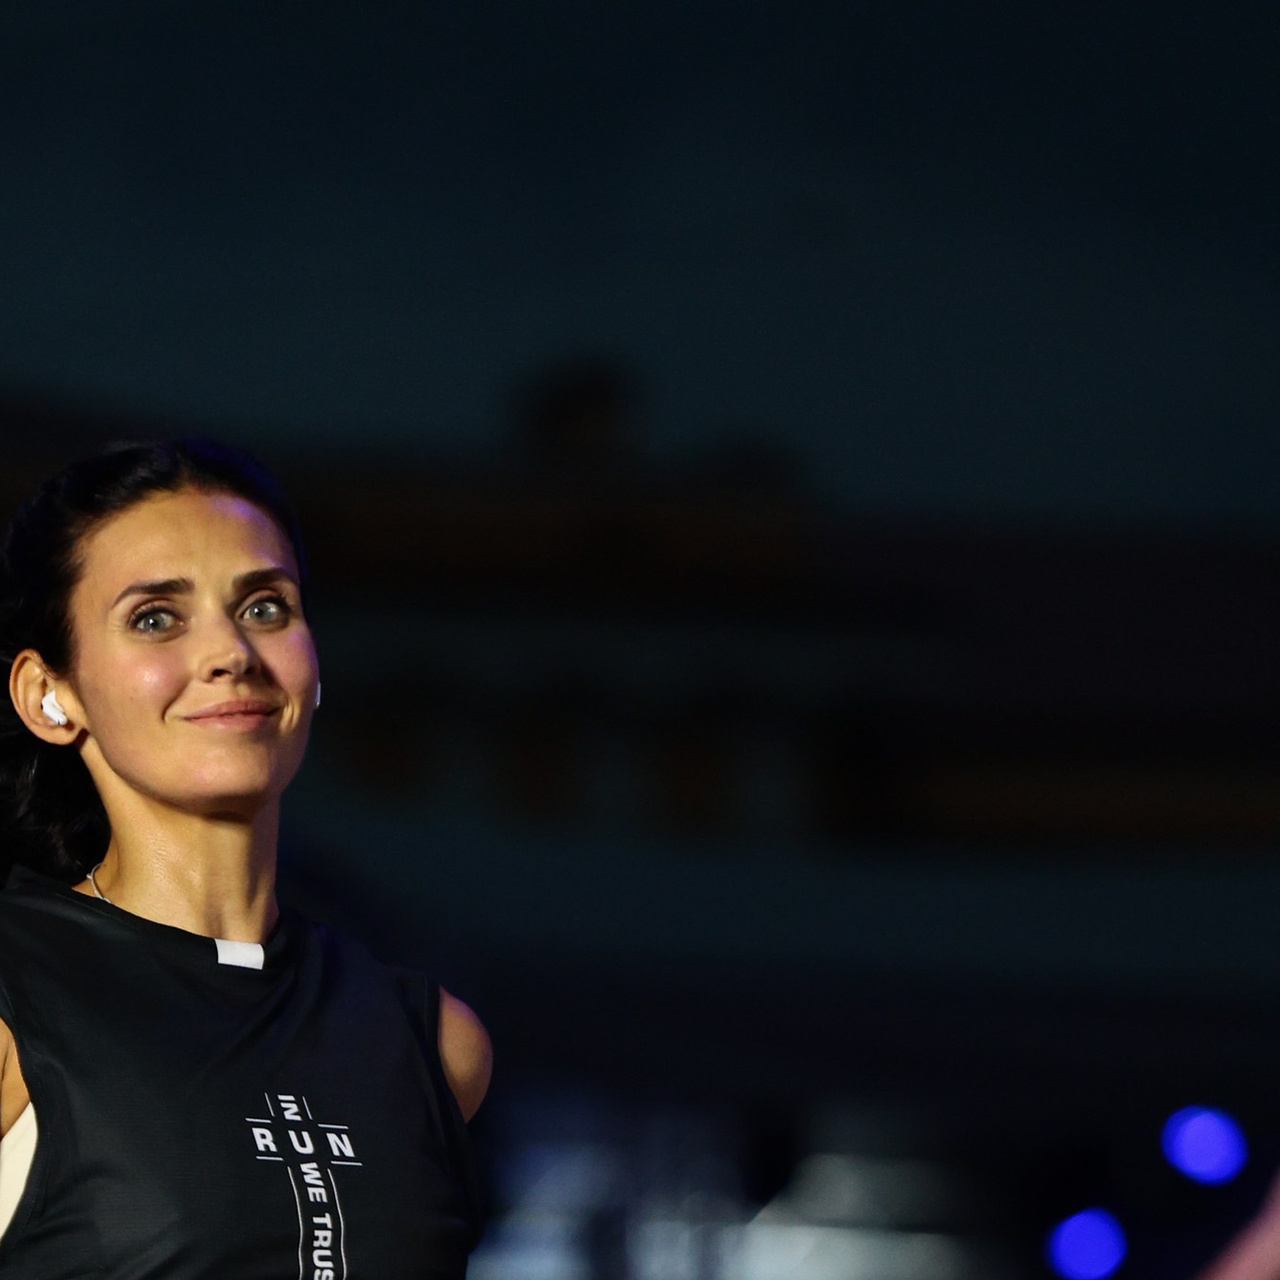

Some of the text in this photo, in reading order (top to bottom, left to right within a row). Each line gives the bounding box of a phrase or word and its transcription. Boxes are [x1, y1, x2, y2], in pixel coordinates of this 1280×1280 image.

[277, 1094, 302, 1121] IN
[251, 1127, 355, 1157] RUN
[299, 1162, 328, 1203] WE
